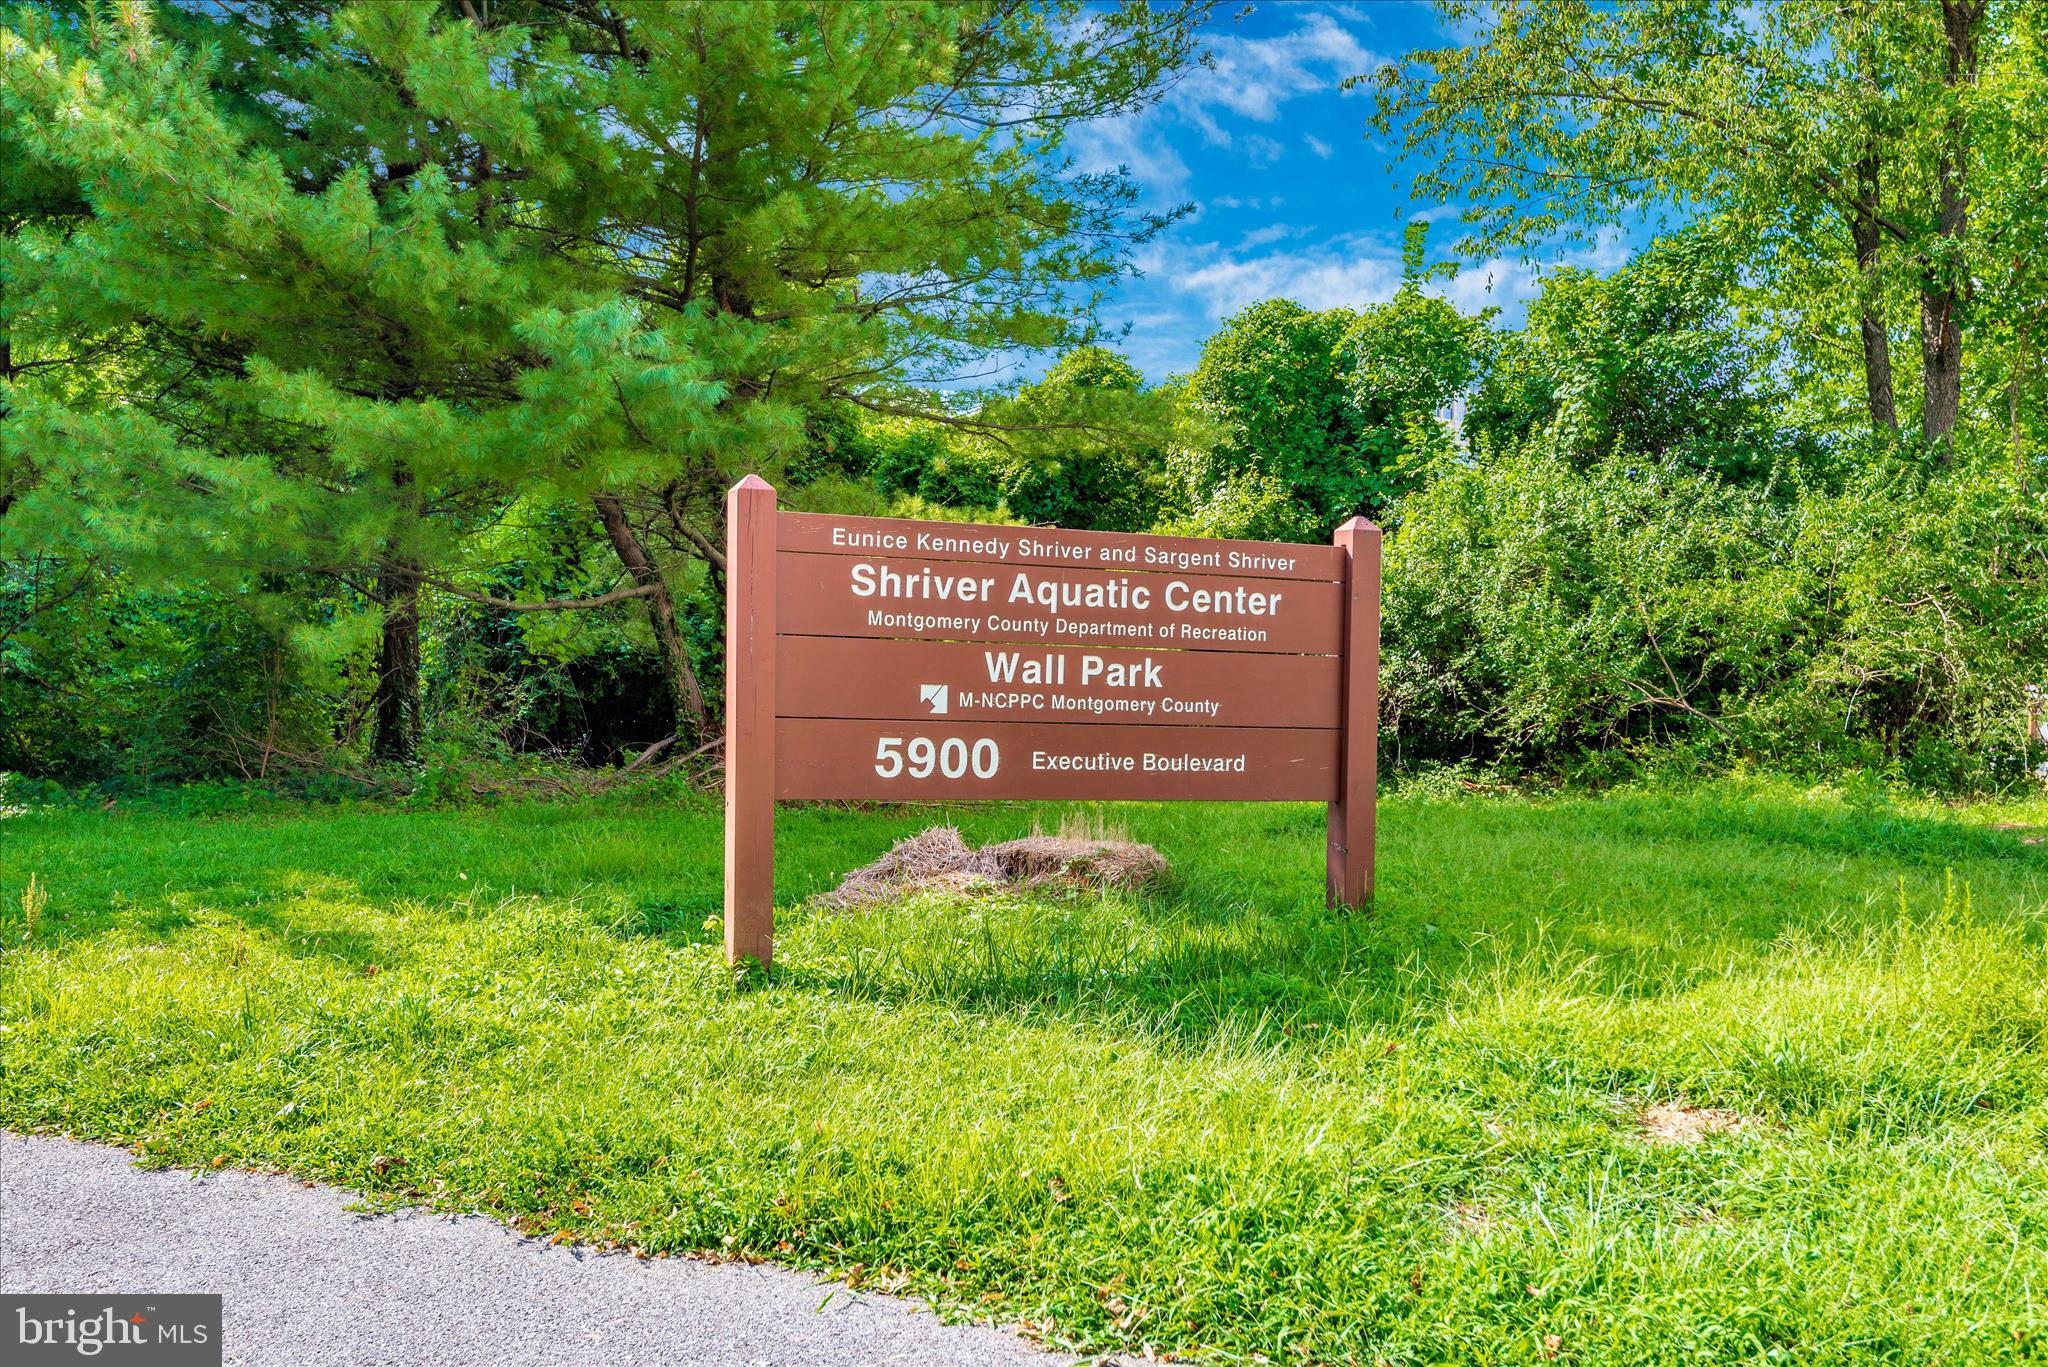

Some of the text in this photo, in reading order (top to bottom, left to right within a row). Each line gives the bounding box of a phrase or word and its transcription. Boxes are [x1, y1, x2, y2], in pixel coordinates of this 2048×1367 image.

[832, 527, 1296, 571] Eunice Kennedy Shriver and Sargent Shriver
[850, 563, 1282, 616] Shriver Aquatic Center
[868, 609, 1267, 642] Montgomery County Department of Recreation
[984, 650, 1163, 688] Wall Park
[959, 691, 1220, 717] M-NCPPC Montgomery County
[874, 737, 1246, 779] 5900 Executive Boulevard
